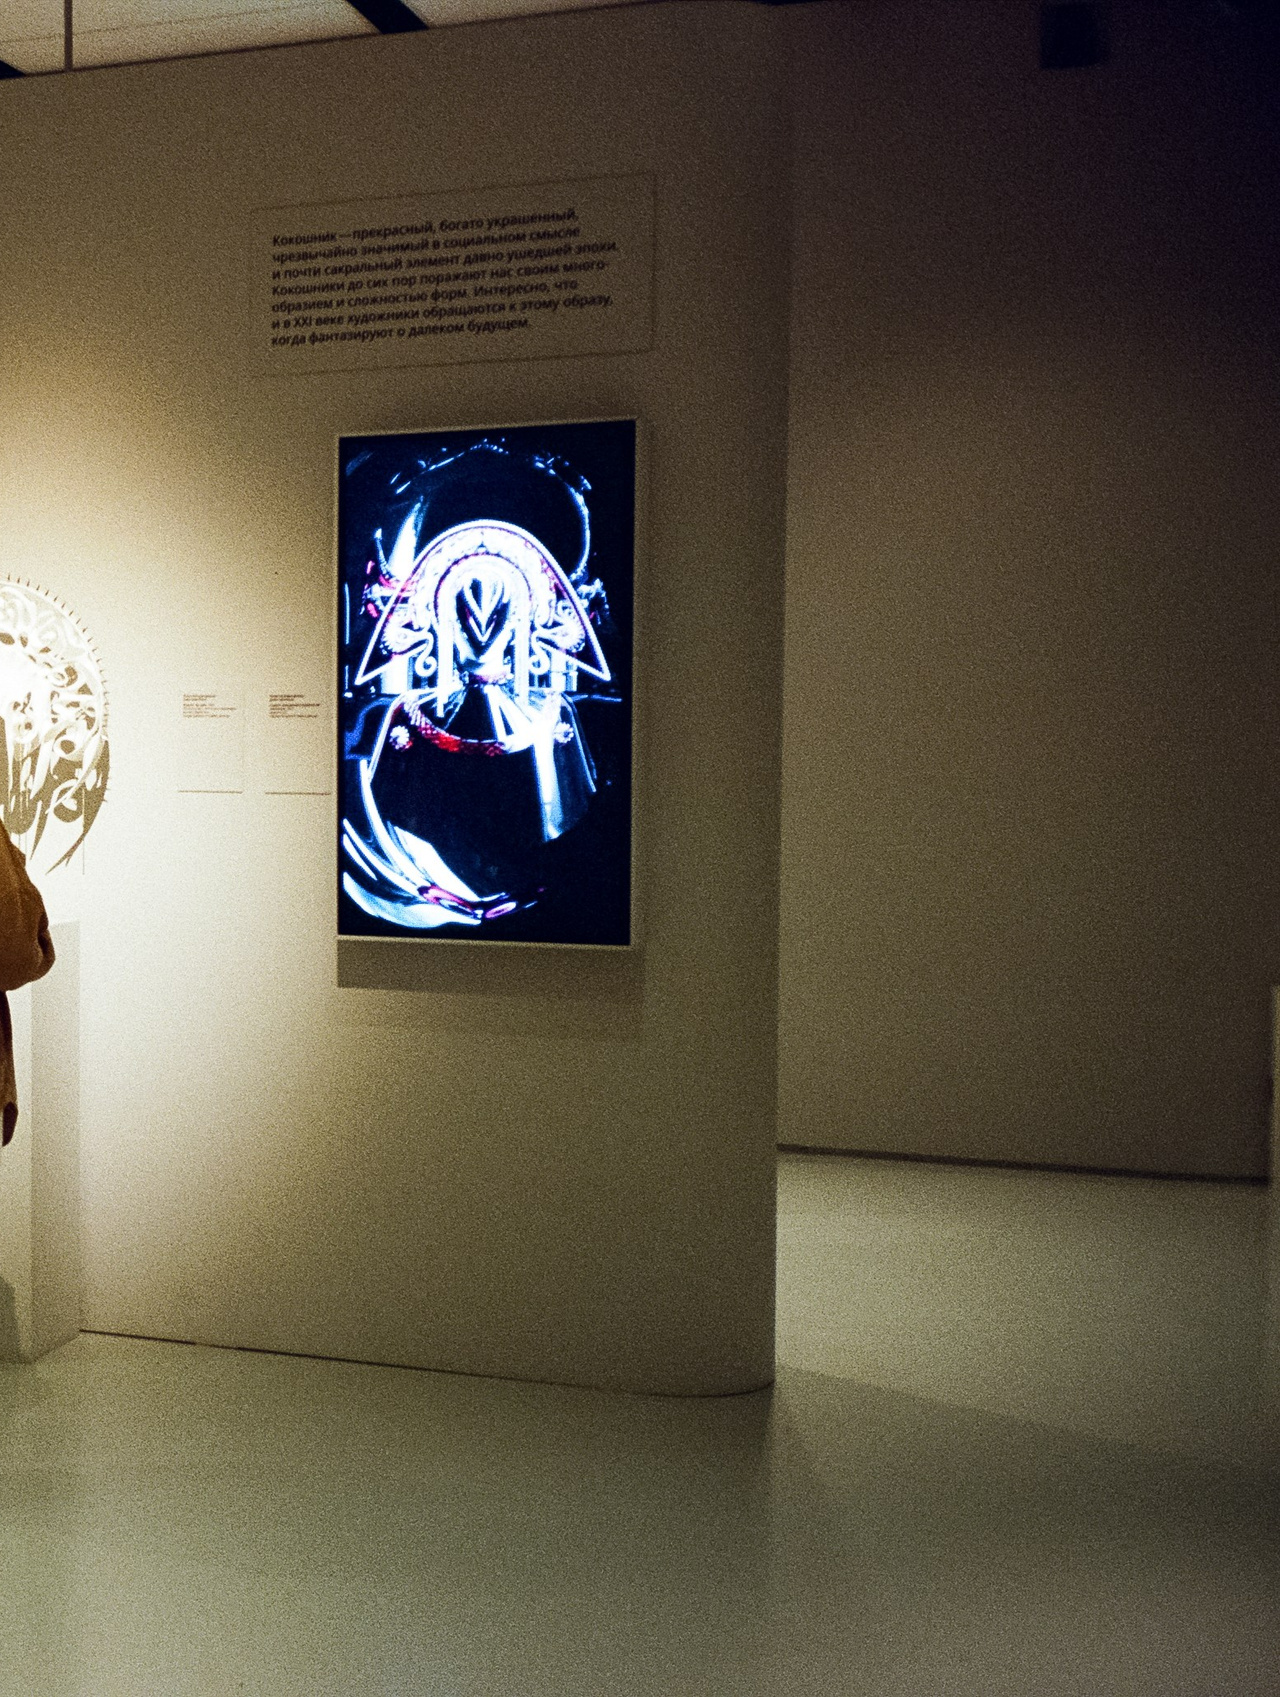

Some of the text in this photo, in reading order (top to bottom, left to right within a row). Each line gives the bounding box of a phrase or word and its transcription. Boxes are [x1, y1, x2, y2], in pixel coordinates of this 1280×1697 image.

[272, 232, 337, 247] Кокошник
[352, 221, 436, 241] прекрасный,
[439, 219, 484, 232] богато
[487, 208, 579, 230] украшенный,
[272, 227, 580, 265] чрезвычайно значимый в социальном смысле
[272, 241, 618, 280] и почти сакральный элемент давно ушедшей эпохи.
[272, 260, 609, 296] Кокошники до сих пор поражают нас своим много-
[272, 298, 333, 313] образием
[336, 297, 345, 307] и
[347, 291, 428, 306] сложностью
[473, 282, 550, 297] Интересно,
[553, 279, 579, 290] что
[271, 294, 613, 329] и в XXI веке художники обращаются к этому образу,
[271, 334, 306, 346] когда
[308, 328, 394, 345] фантазируют
[396, 327, 405, 337] о
[407, 323, 464, 337] далеком
